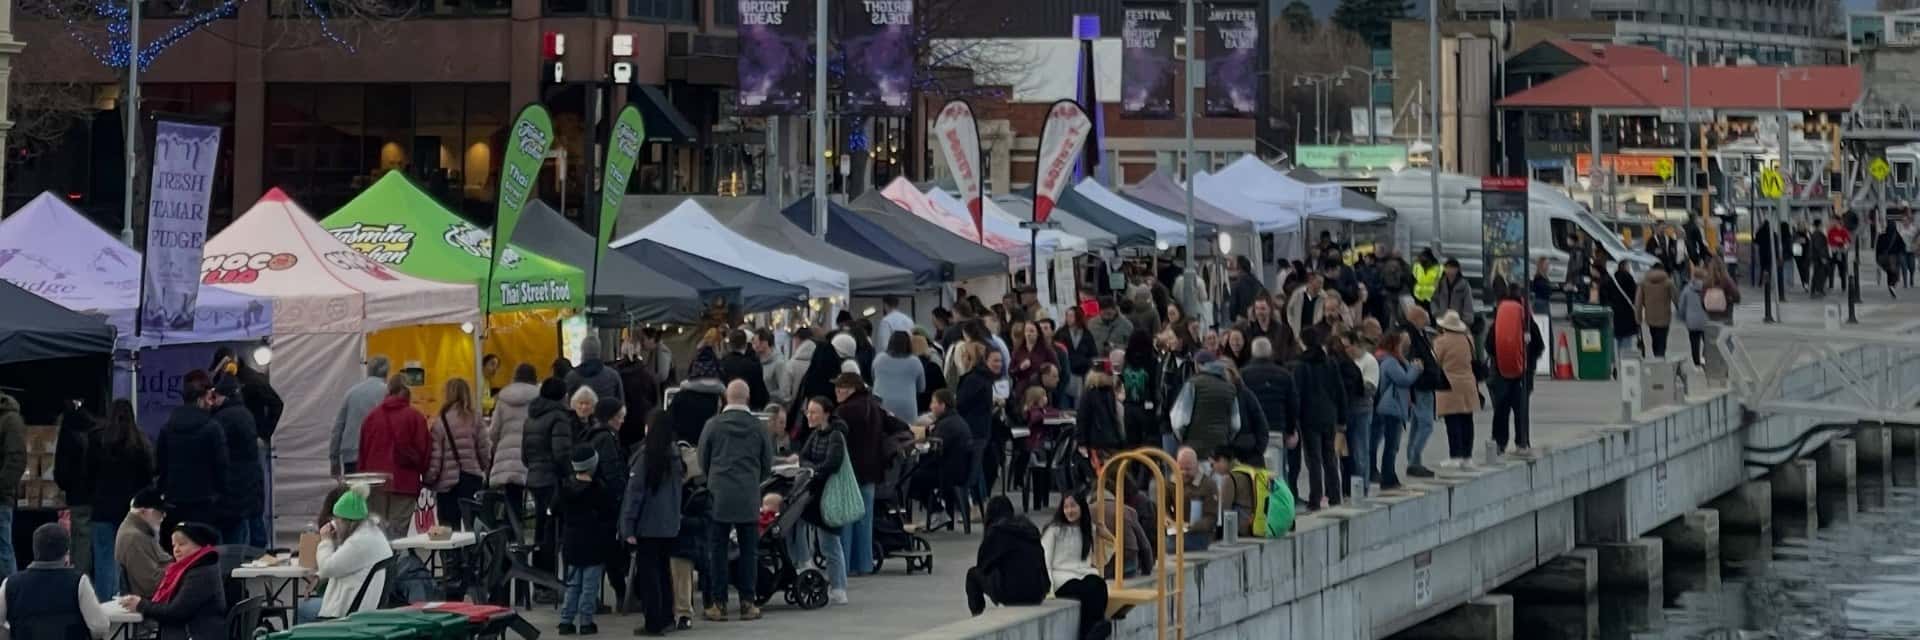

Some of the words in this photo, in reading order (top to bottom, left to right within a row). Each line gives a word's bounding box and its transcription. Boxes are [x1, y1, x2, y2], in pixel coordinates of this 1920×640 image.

[742, 0, 789, 13] BRIGHT
[1125, 9, 1172, 20] FESTIVAL
[743, 13, 782, 25] IDEAS
[157, 171, 208, 193] FRESH
[509, 164, 529, 188] Thai
[151, 199, 204, 221] TAMAR
[150, 229, 203, 249] FUDGE
[202, 252, 298, 271] HOCO
[500, 281, 519, 305] Thai
[521, 281, 549, 304] Street
[550, 279, 571, 302] Food
